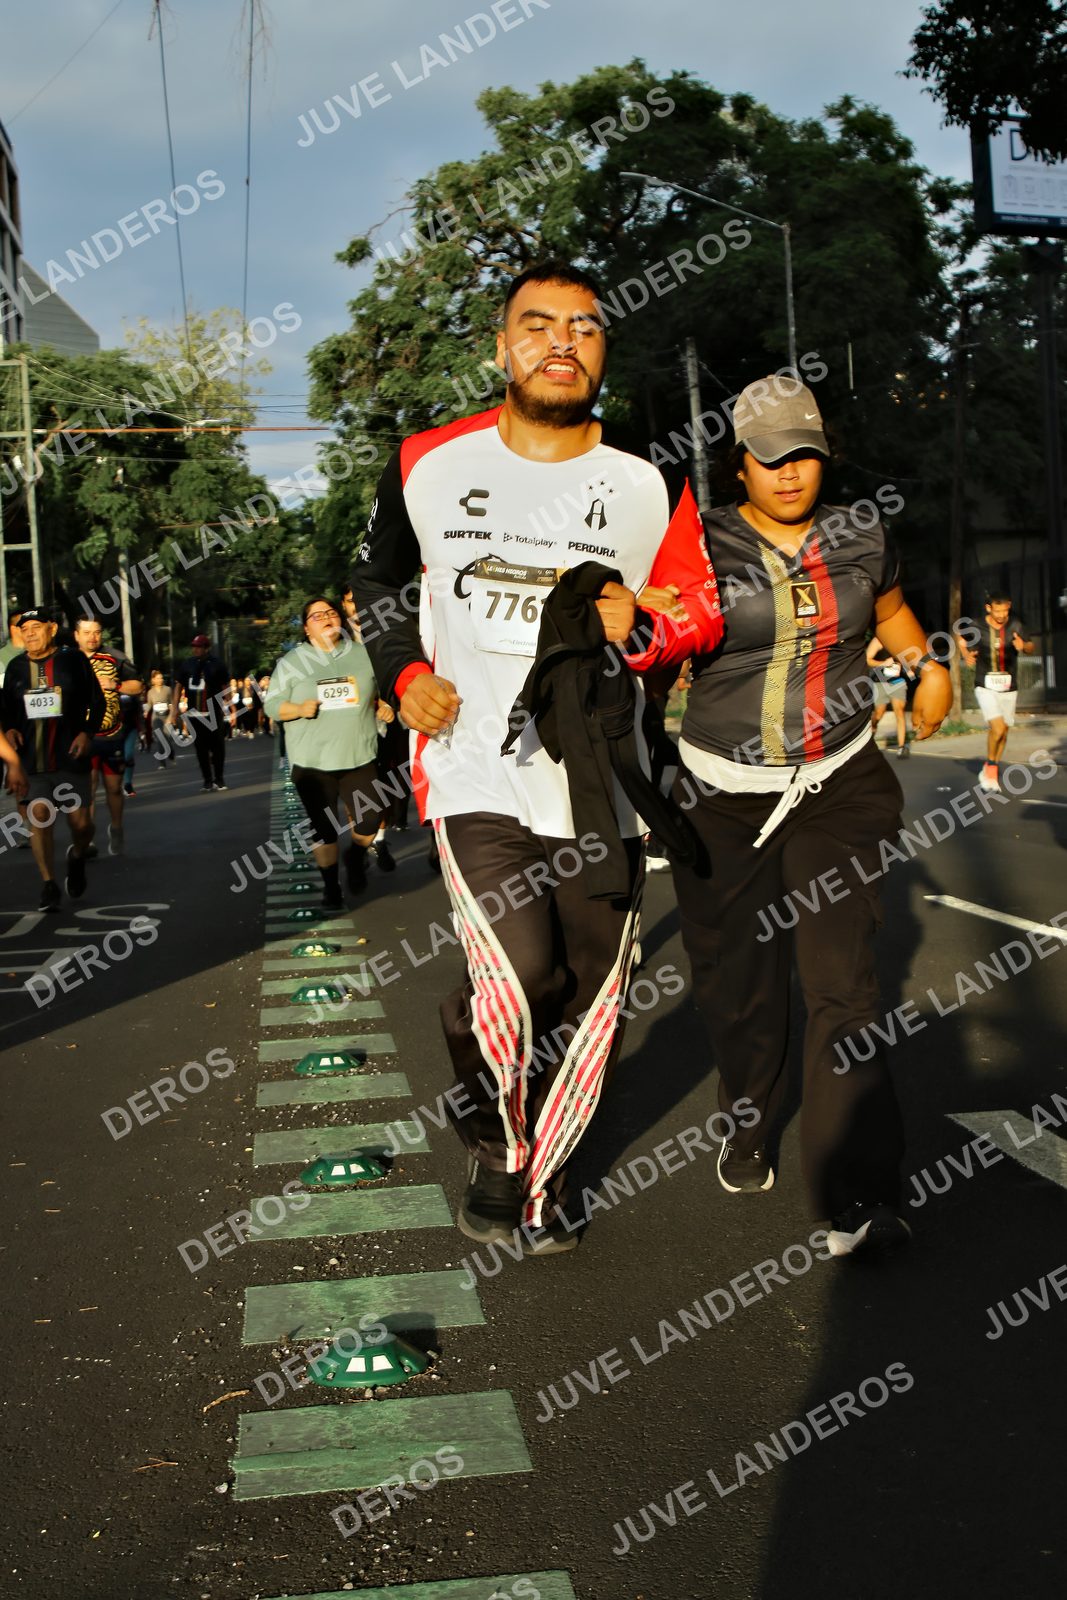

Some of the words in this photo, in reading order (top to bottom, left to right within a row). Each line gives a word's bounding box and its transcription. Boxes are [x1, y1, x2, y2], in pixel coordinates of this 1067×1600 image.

[443, 530, 493, 541] SURTEK
[568, 541, 617, 558] PERDURA
[486, 590, 547, 624] 776
[323, 686, 350, 699] 6299
[29, 696, 55, 708] 4033
